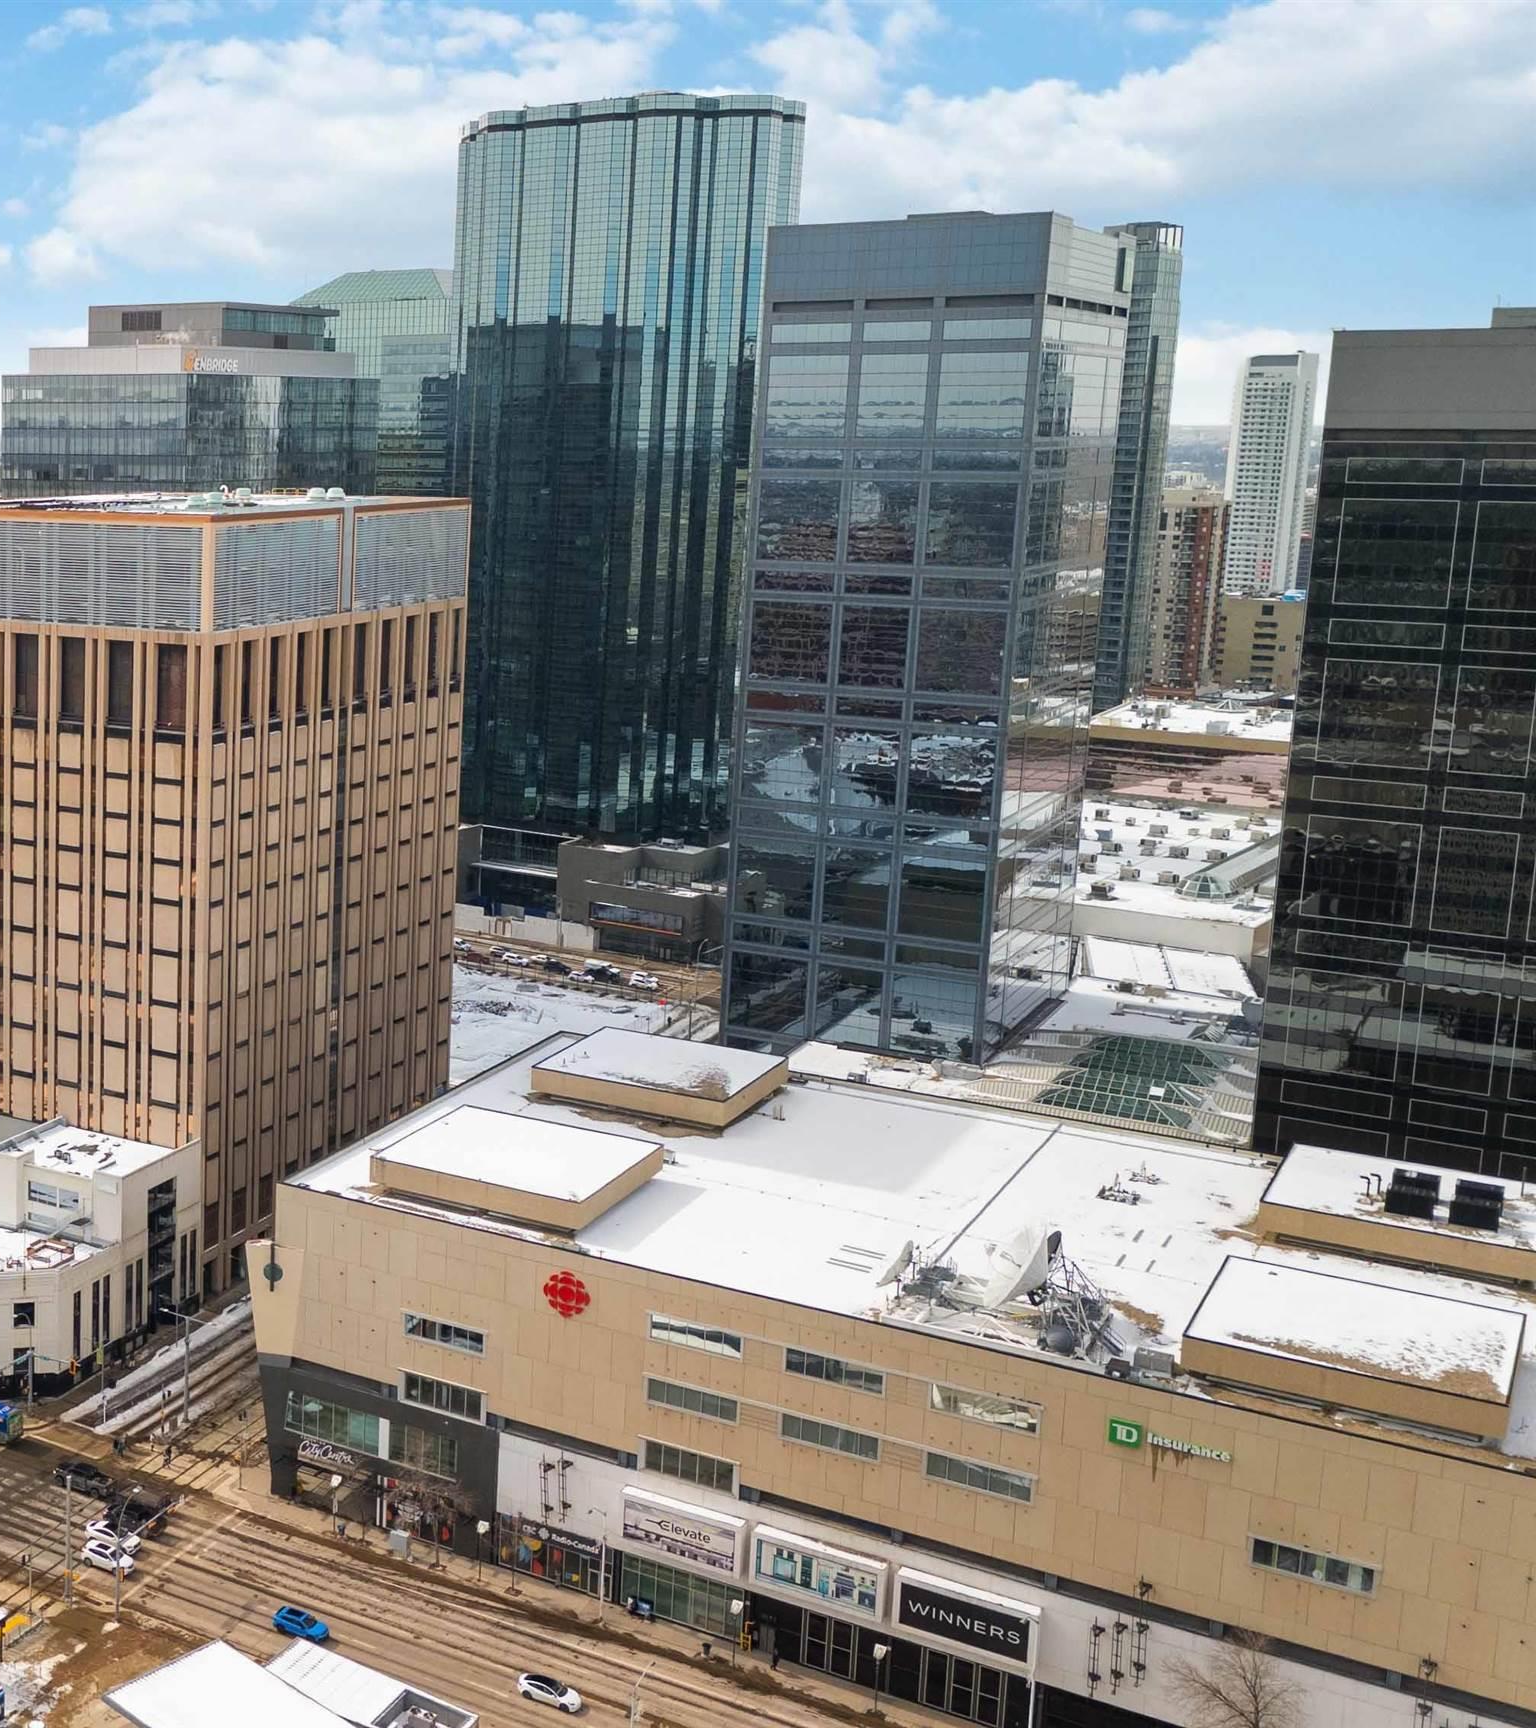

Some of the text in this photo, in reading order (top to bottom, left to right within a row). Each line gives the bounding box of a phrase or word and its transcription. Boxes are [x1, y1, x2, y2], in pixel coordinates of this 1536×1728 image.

[195, 357, 239, 373] ENBRIDGE
[1111, 1423, 1232, 1463] TD Insurance
[652, 1519, 711, 1544] Elevate
[908, 1599, 1021, 1645] WINNERS
